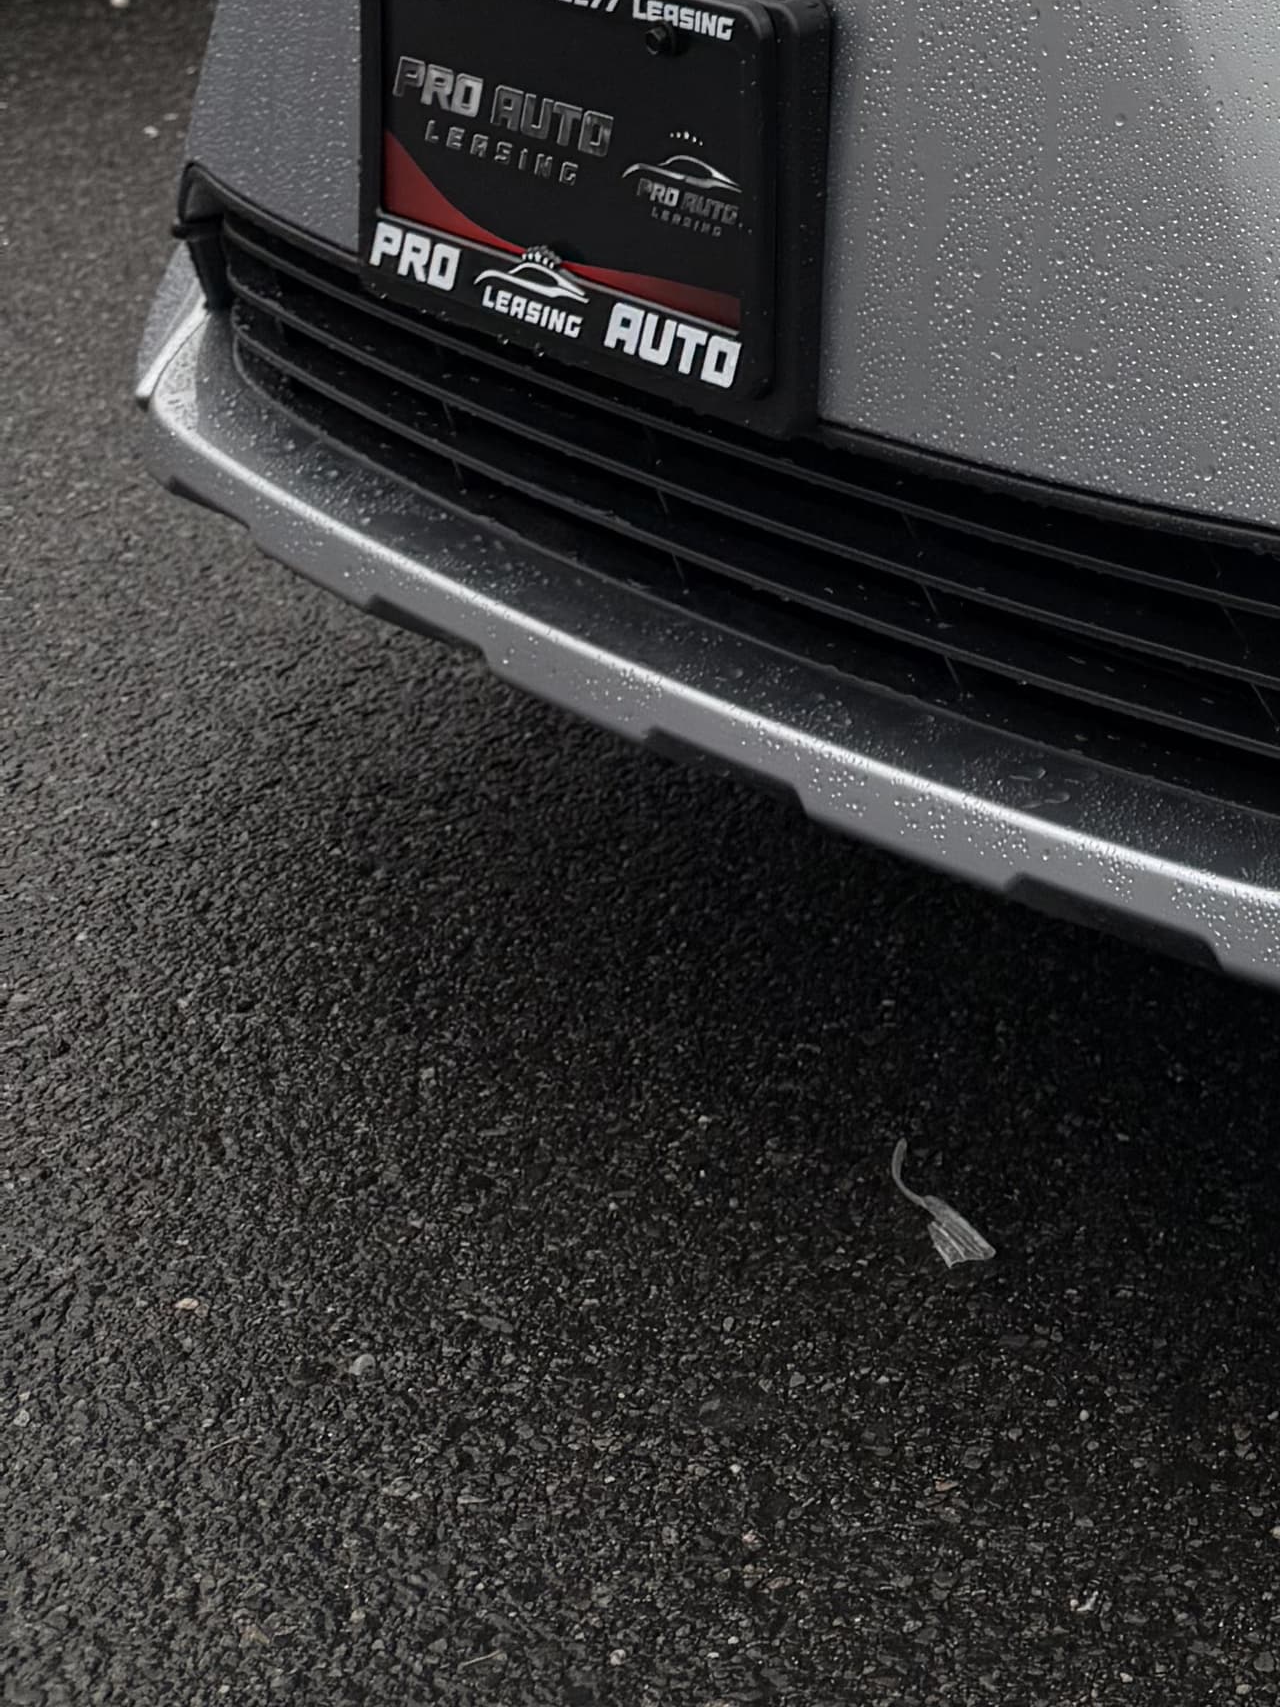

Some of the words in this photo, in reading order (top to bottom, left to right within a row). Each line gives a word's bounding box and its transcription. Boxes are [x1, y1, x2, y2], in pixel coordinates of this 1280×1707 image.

[393, 54, 485, 119] PRO
[491, 83, 615, 158] AUTO
[424, 119, 579, 187] LEASING
[636, 177, 680, 208] PRO
[681, 191, 741, 222] AUTO
[369, 221, 462, 293] PRO
[481, 284, 584, 339] LEASING
[603, 301, 743, 389] AUTO
